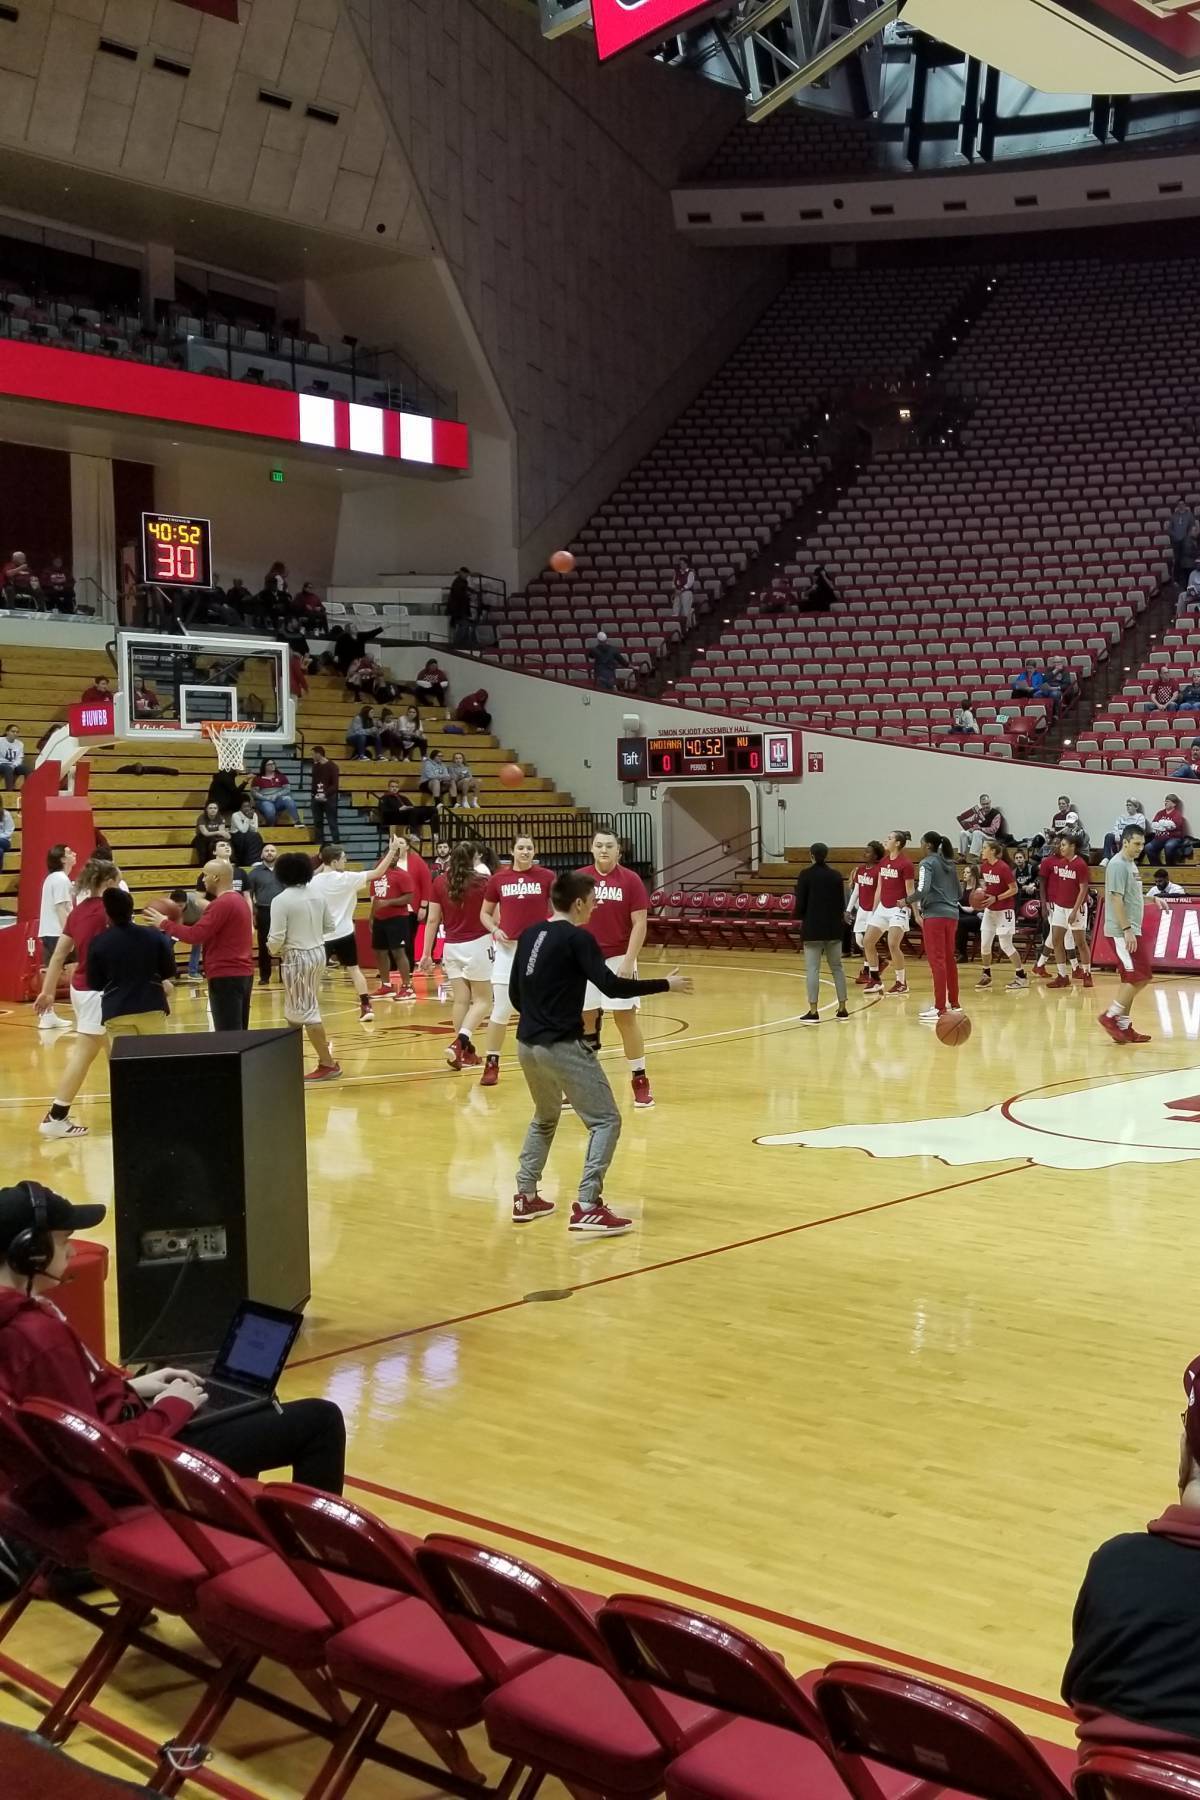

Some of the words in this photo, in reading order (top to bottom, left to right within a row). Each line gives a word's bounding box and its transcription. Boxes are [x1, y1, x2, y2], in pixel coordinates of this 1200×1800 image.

[149, 523, 200, 544] 40:52
[158, 544, 194, 578] 30
[81, 709, 108, 726] #IUWBB
[650, 740, 682, 750] INDIANA
[687, 739, 720, 755] 40:52
[737, 737, 748, 747] NU
[622, 752, 639, 765] Taft
[663, 755, 671, 771] 0
[750, 752, 758, 769] 0
[813, 760, 819, 770] 3
[501, 882, 541, 897] INDIANA
